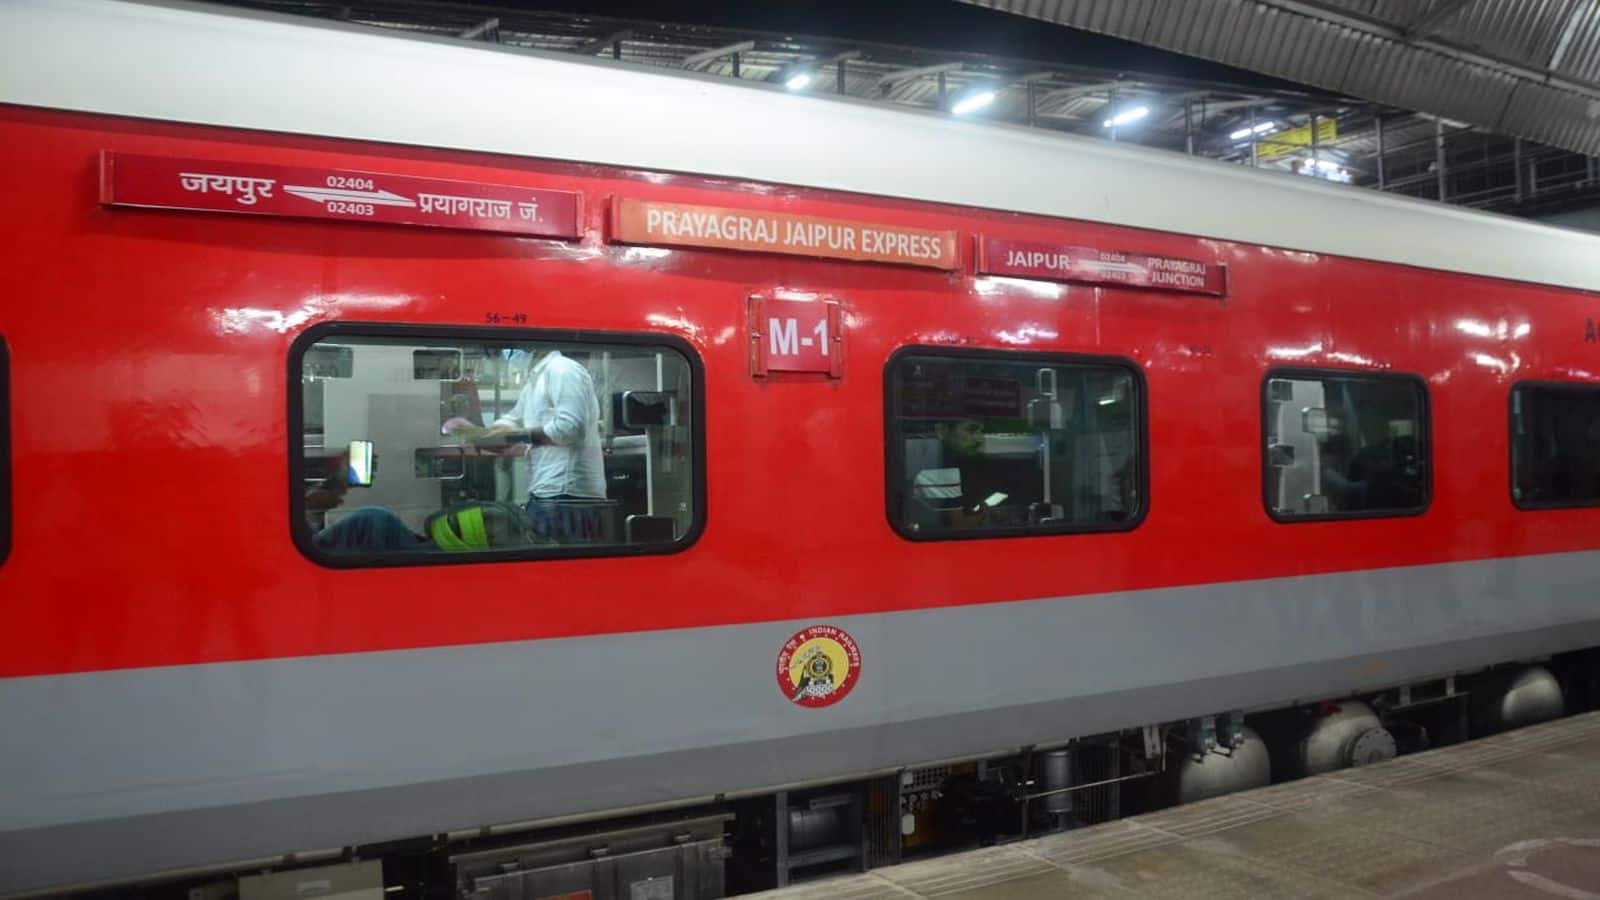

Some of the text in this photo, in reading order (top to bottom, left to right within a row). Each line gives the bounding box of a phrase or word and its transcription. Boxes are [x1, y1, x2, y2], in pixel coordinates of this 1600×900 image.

[326, 175, 375, 190] 02404
[179, 172, 544, 222] जयपुर प्रयागराज जं.
[326, 201, 375, 216] 02403
[645, 207, 941, 260] PRAYAGRAJ JAIPUR EXPRESS
[1005, 250, 1072, 270] JAIPUR
[1151, 271, 1205, 288] JUNCTION
[768, 317, 830, 357] M-1
[807, 626, 838, 636] INDIAN
